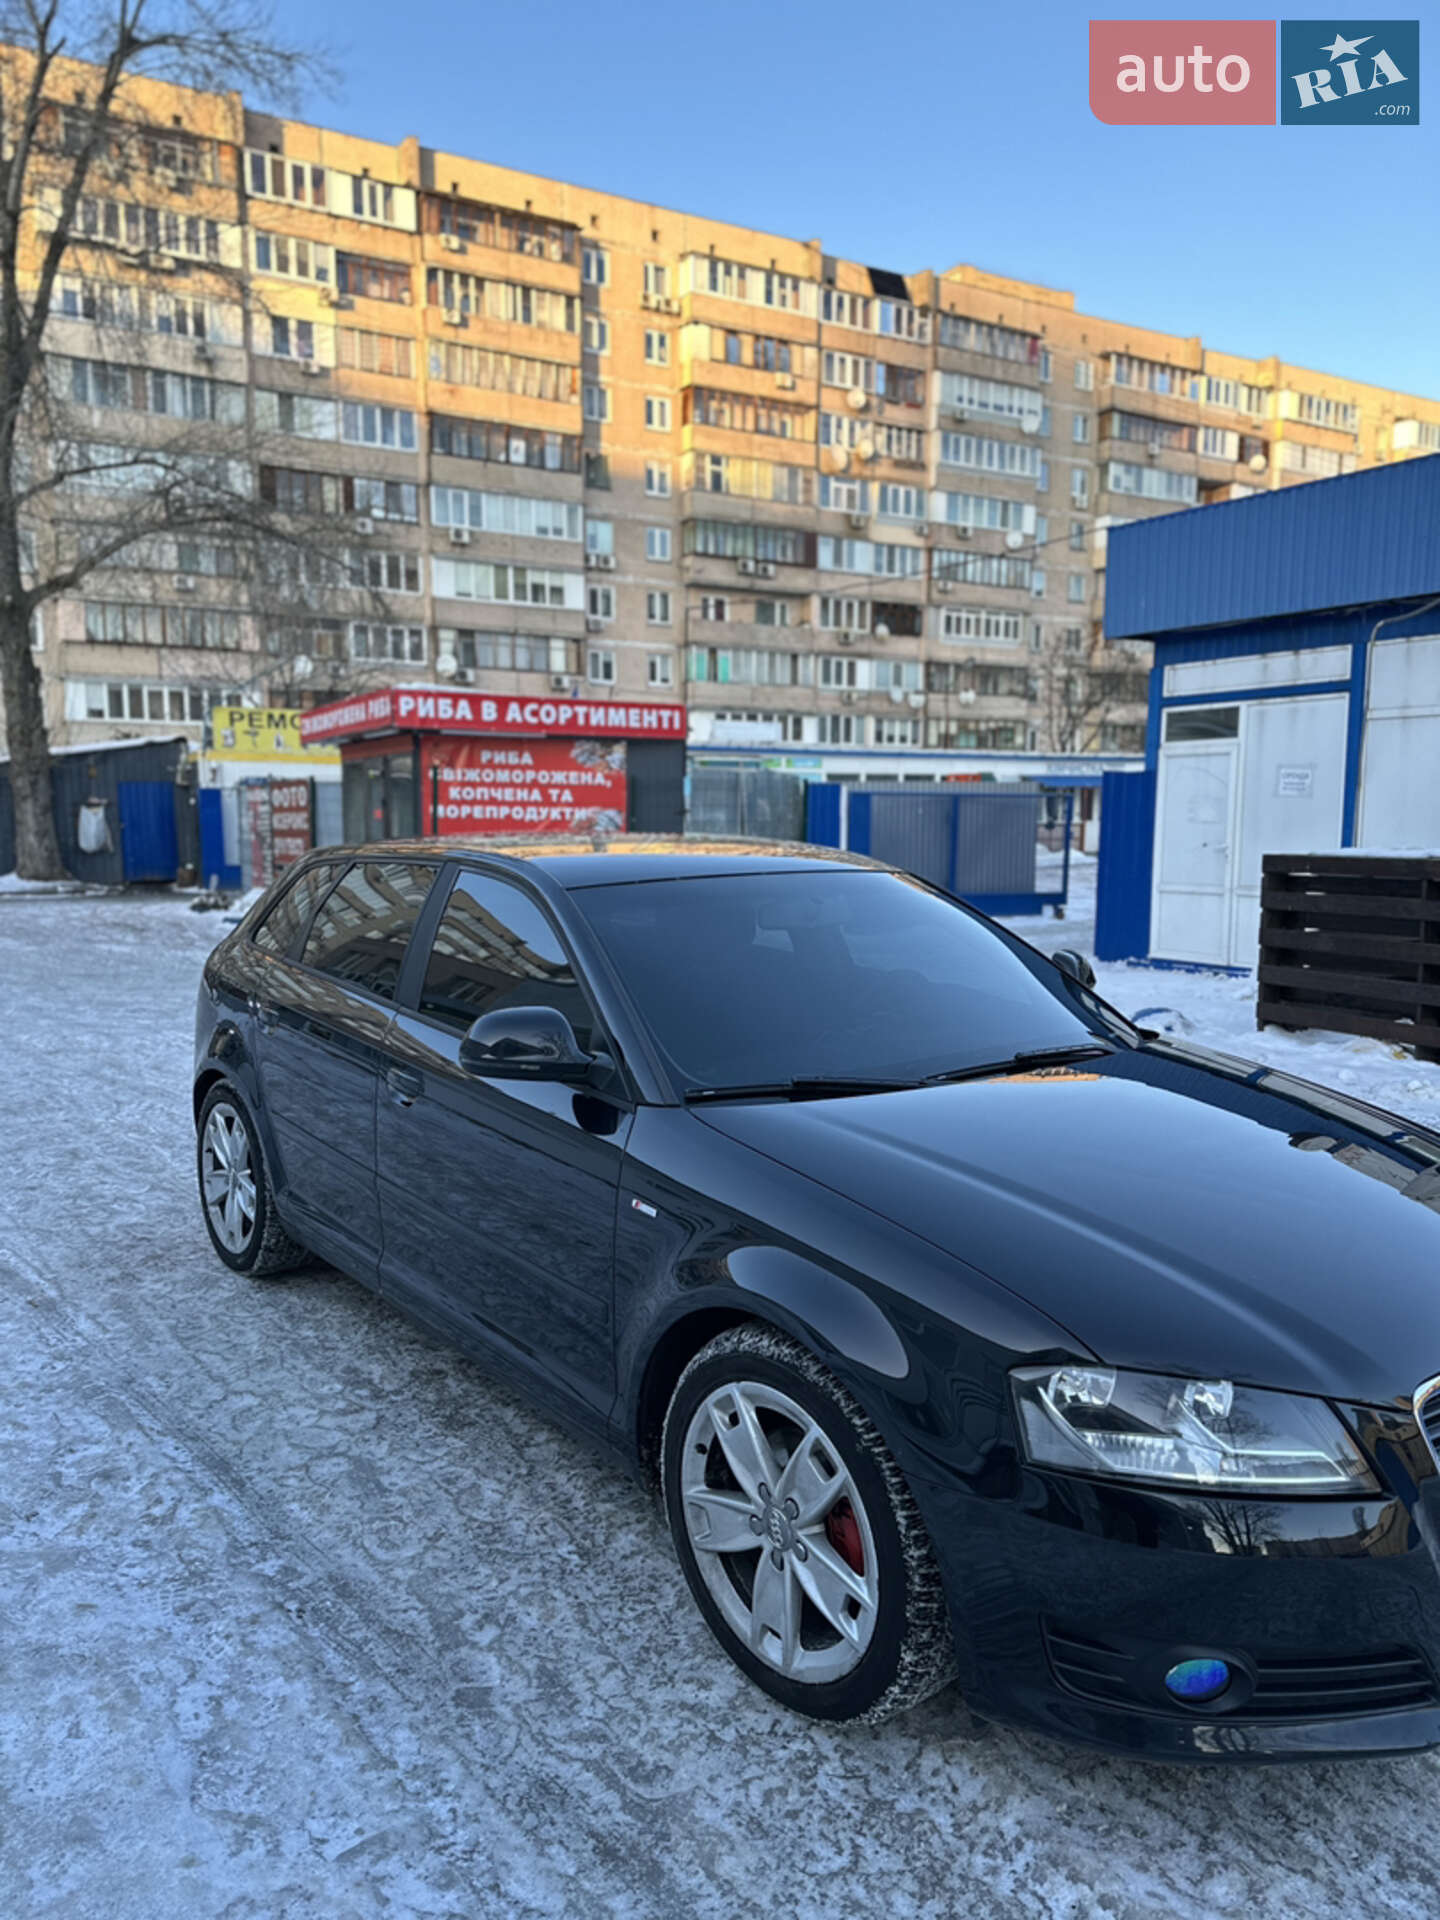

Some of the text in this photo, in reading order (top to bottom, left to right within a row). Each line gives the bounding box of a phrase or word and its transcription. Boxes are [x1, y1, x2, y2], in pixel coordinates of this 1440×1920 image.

[399, 695, 680, 730] РИБА В АСОРТИМЕНТІ
[480, 750, 534, 765] РИБА
[449, 786, 573, 803] КОПЧЕНА ТА
